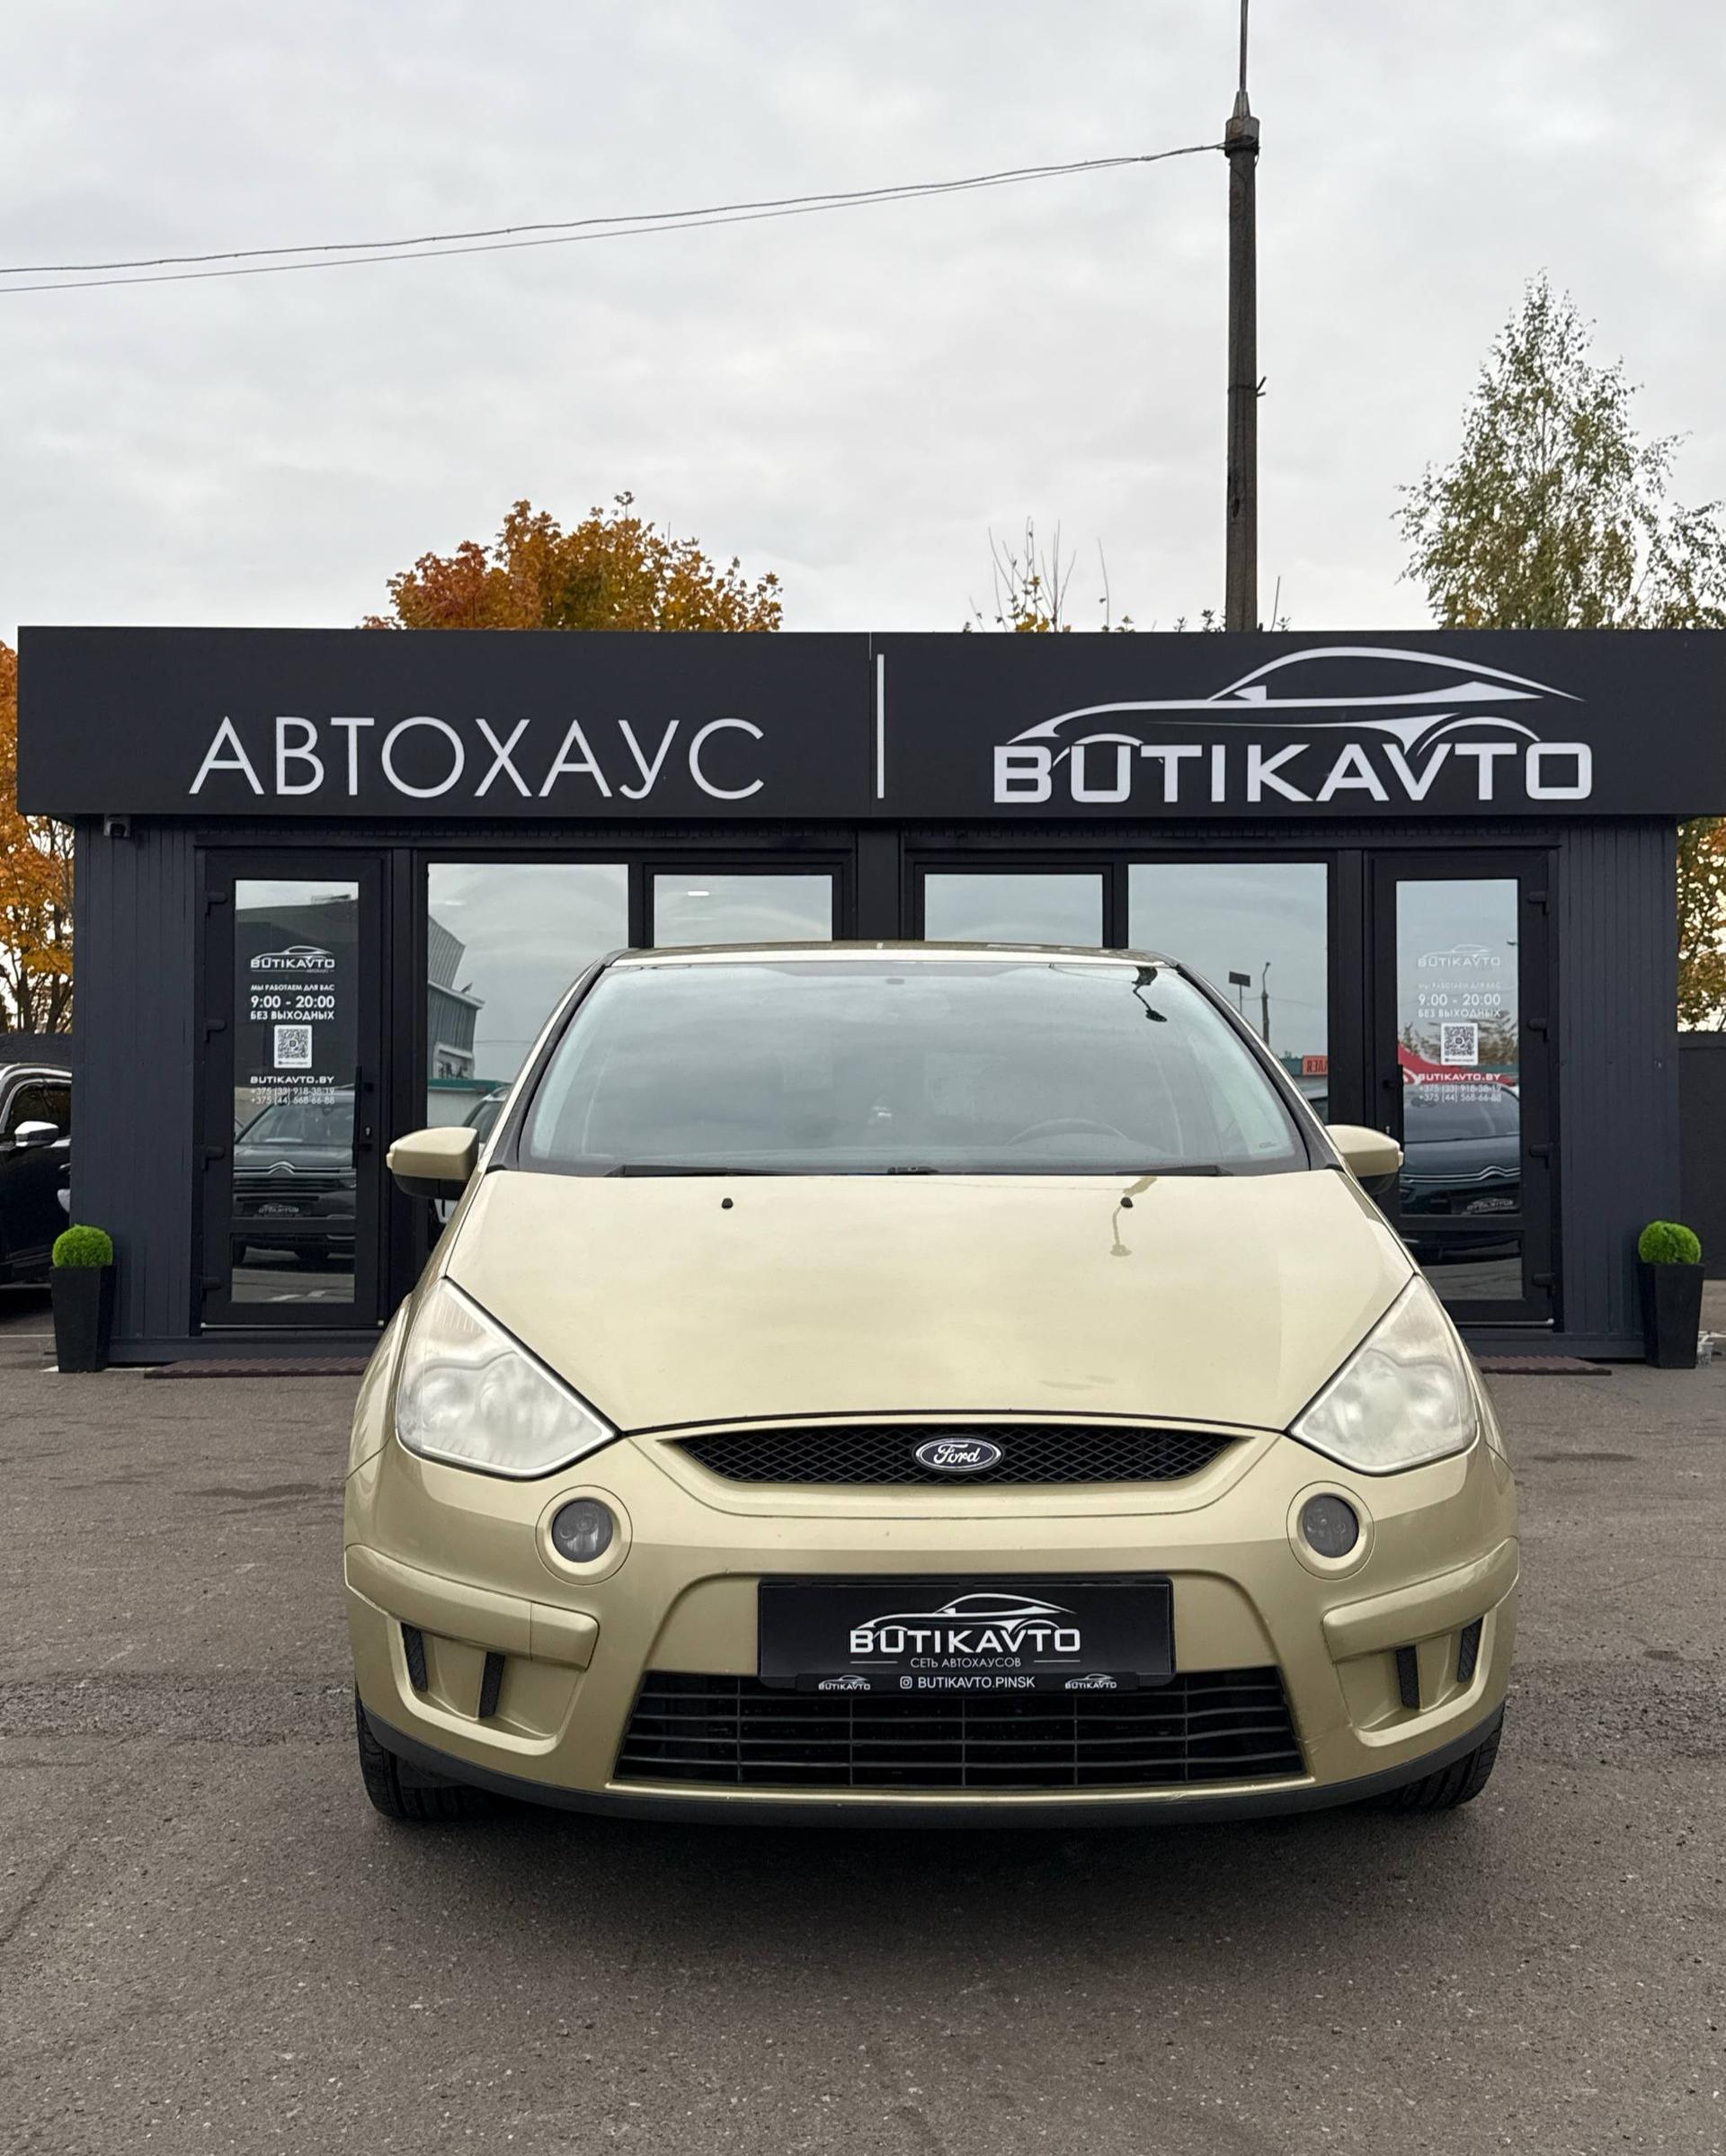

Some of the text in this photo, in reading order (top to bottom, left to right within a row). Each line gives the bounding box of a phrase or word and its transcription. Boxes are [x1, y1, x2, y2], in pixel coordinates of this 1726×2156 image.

[189, 716, 764, 800] АВТОХАУС
[993, 742, 1592, 804] BUTIKAVTO
[250, 958, 335, 968] BUTIKAVTO
[1418, 956, 1500, 967] BUTIKAVTO
[251, 995, 281, 1009] 9:00
[296, 995, 335, 1009] 20:00
[1419, 993, 1447, 1006] 9:00
[1463, 993, 1501, 1006] 20:00
[250, 1011, 334, 1020] БЕЗ ВЫХОДНЫХ
[1418, 1009, 1501, 1018] БЕЗ ВЫХОДНЫХ
[250, 1076, 335, 1084] BUTIKAVTO.BY
[1419, 1073, 1501, 1082] BUTIKAVTO.BY
[933, 1443, 982, 1465] Ford
[850, 1627, 1081, 1654] BUTIKAVTO
[910, 1657, 1022, 1669] СЕТЬ АВТОХАУСОВ
[818, 1682, 871, 1691] BUTIKAVTO
[918, 1675, 1036, 1689] BUTIKAVTO.PINSK
[1064, 1680, 1117, 1689] BUTIKAVTO
